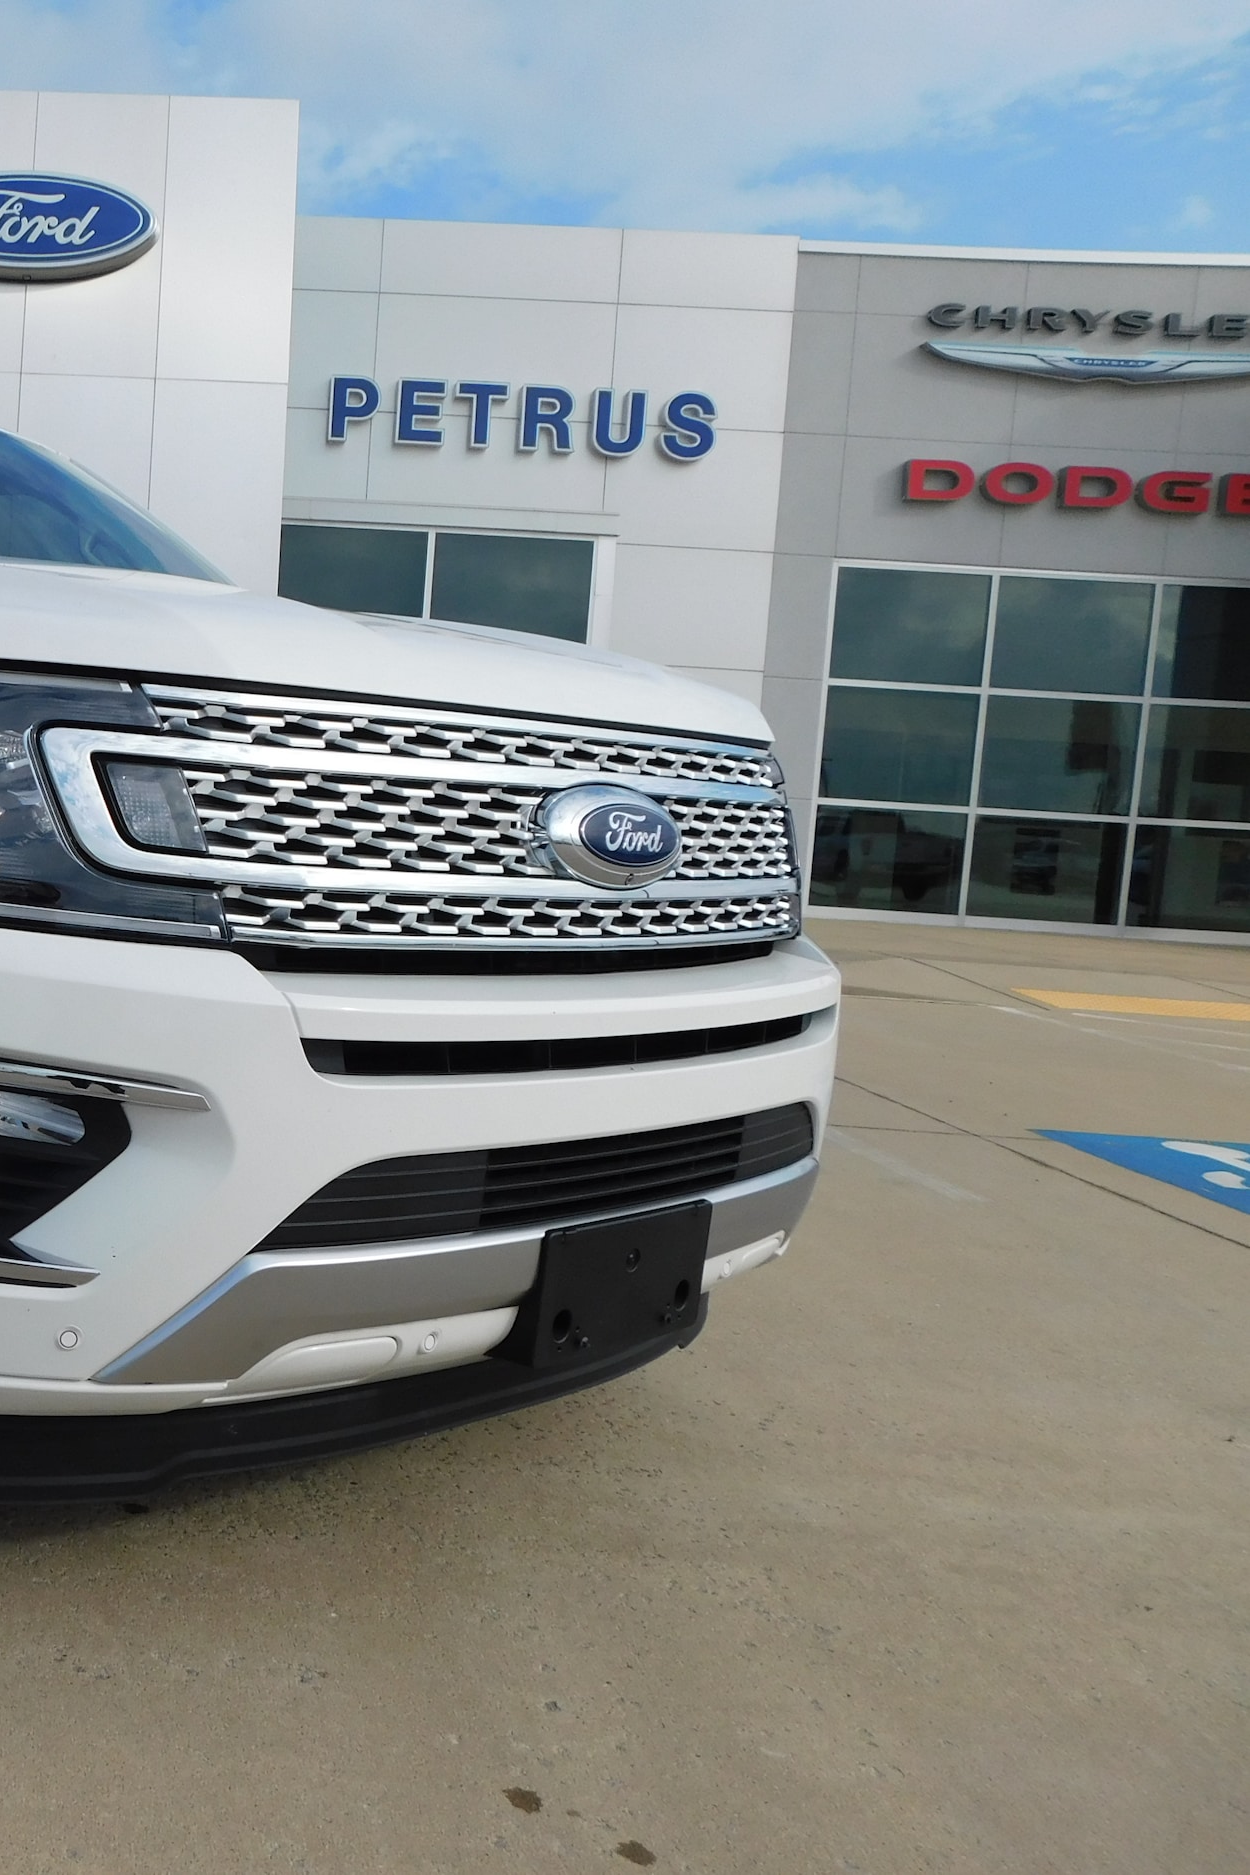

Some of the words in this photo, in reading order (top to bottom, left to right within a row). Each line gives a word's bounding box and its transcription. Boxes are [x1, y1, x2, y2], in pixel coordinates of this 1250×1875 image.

[927, 302, 1250, 338] CHRYSLE
[327, 374, 719, 463] PETRUS
[605, 811, 664, 853] Ford
